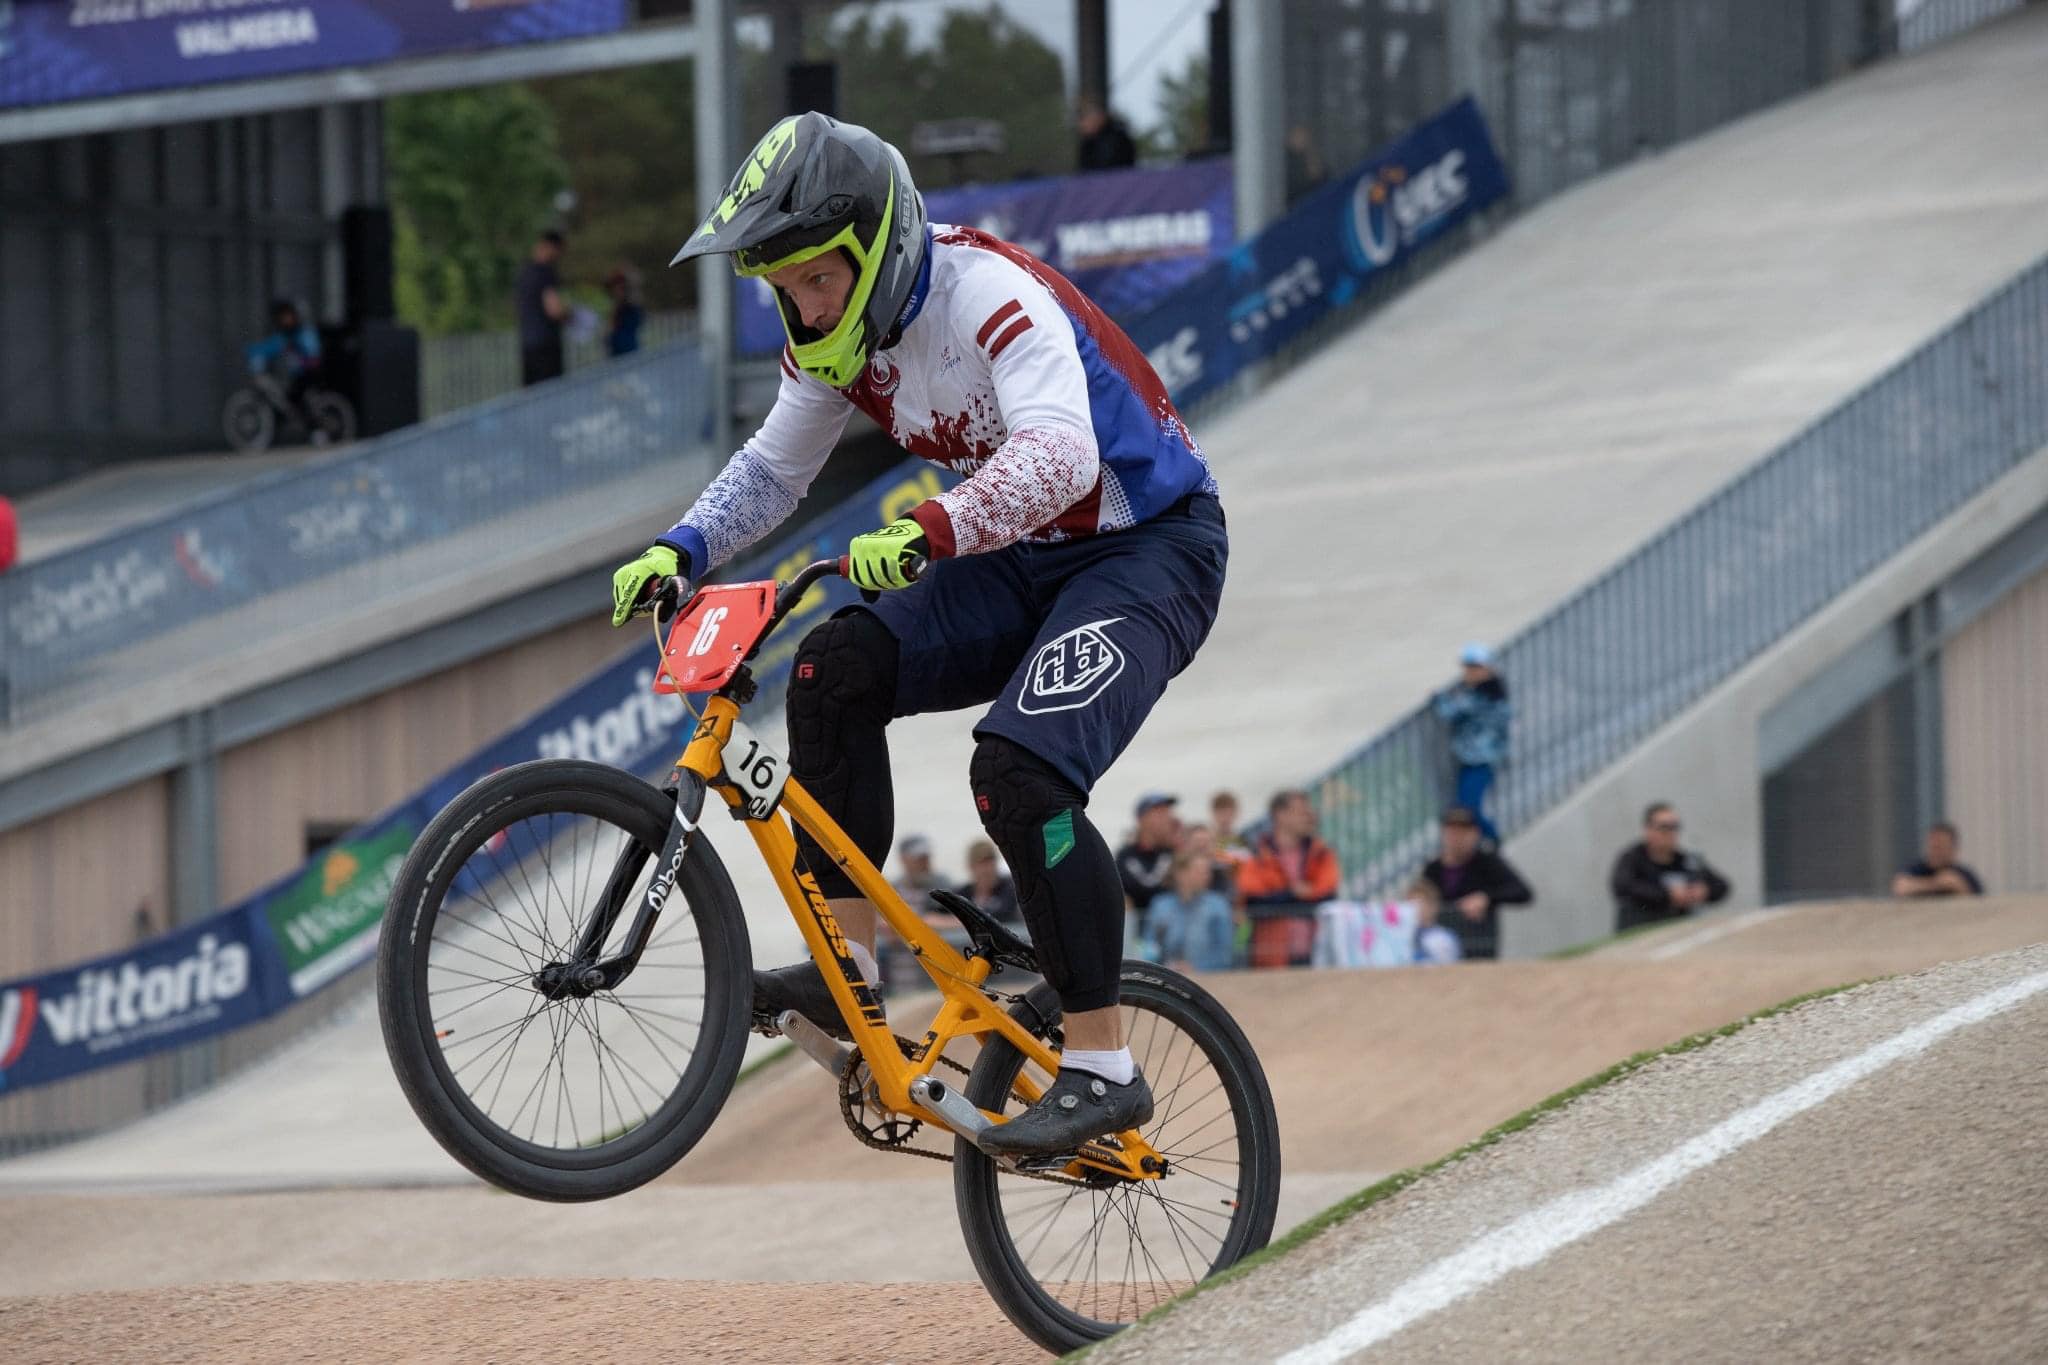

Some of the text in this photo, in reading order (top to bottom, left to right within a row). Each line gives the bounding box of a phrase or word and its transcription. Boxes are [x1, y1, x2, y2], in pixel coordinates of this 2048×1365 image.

[174, 7, 319, 58] VALMIERA
[686, 606, 729, 657] 16
[738, 740, 777, 790] 16
[41, 933, 249, 1045] vittoria
